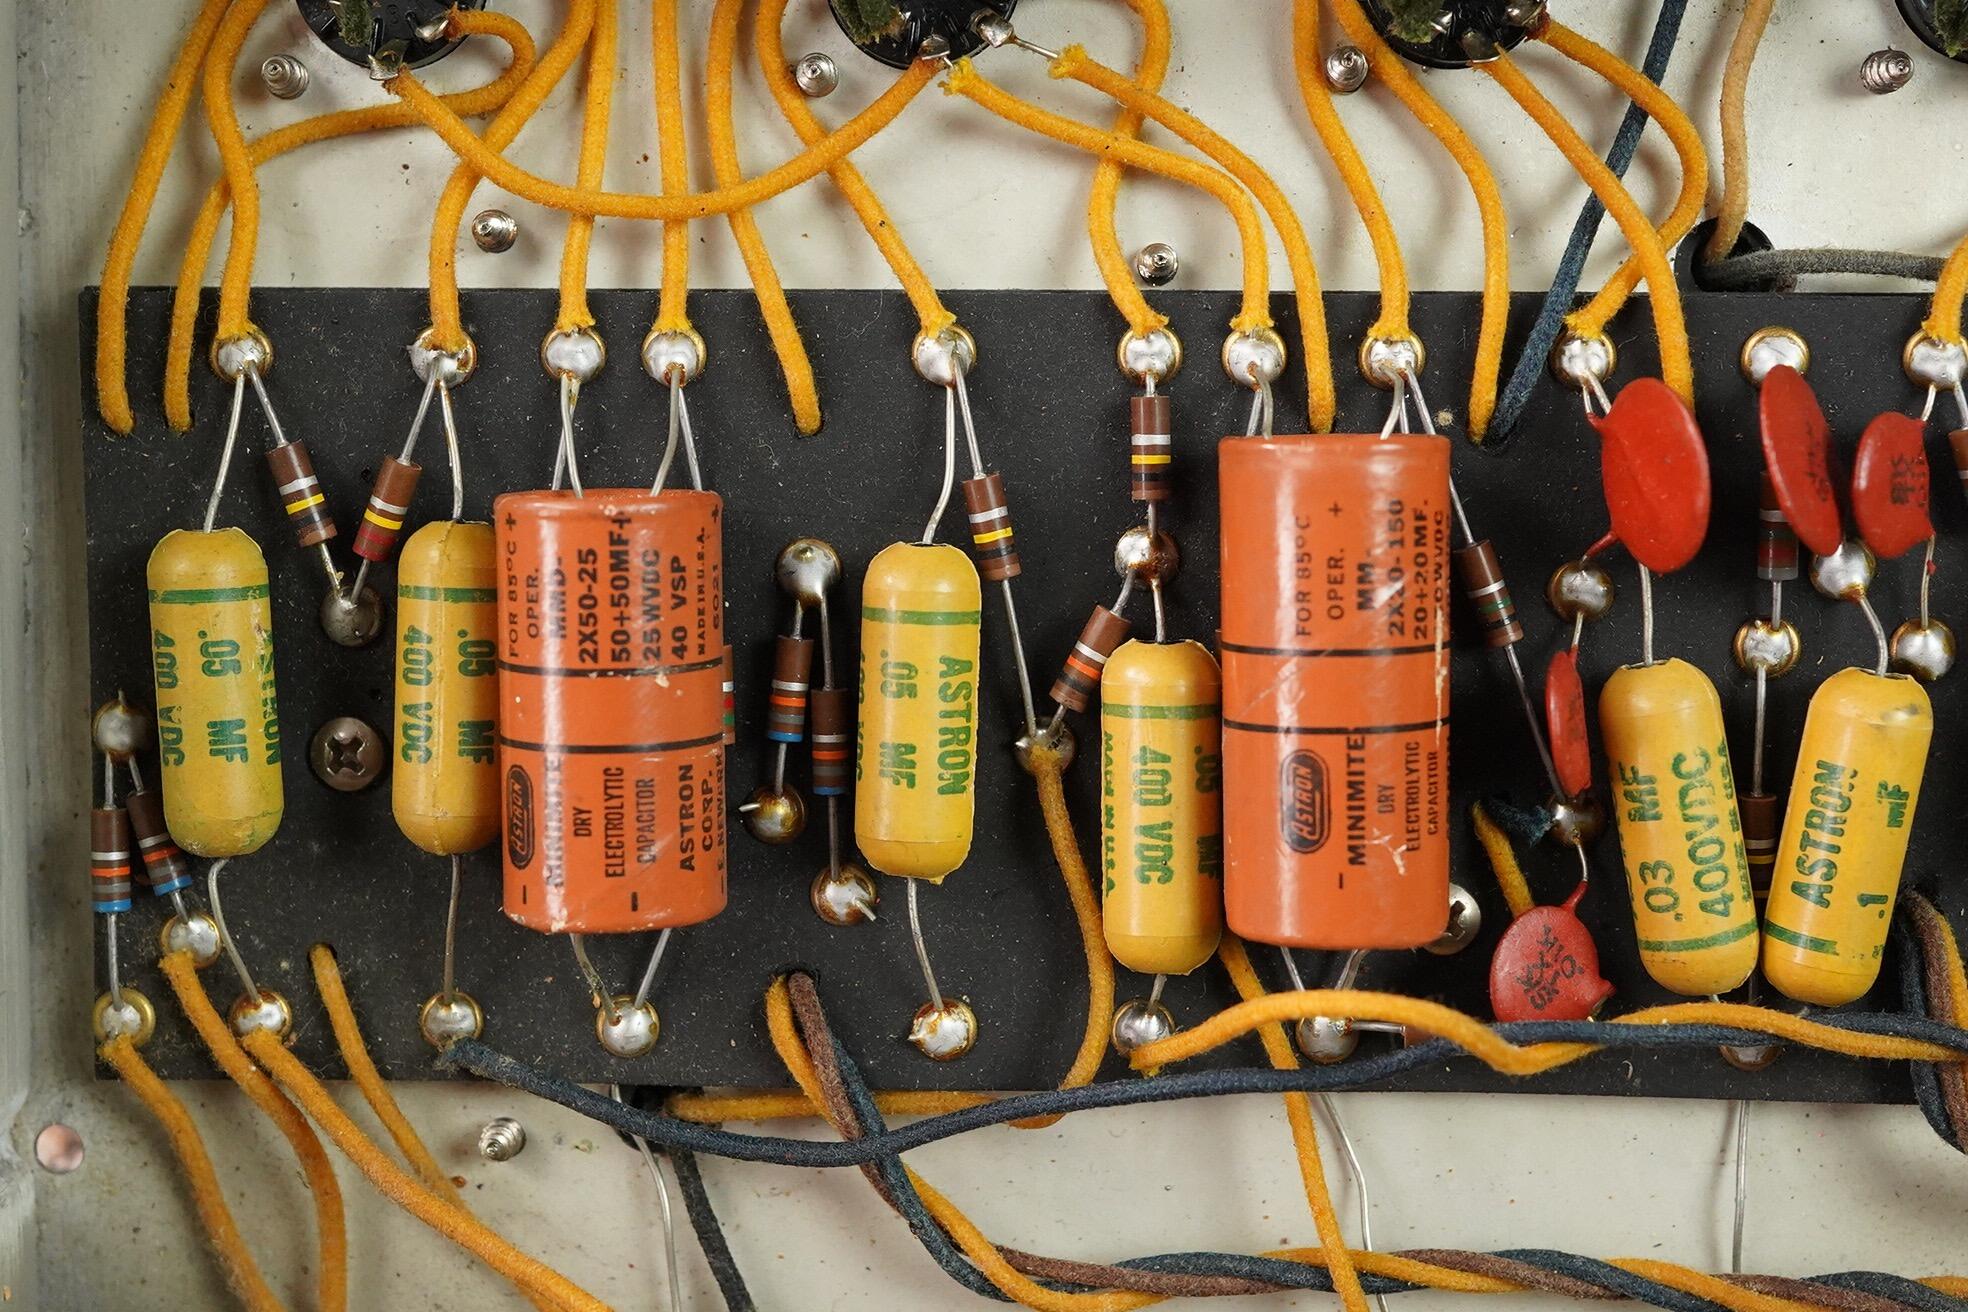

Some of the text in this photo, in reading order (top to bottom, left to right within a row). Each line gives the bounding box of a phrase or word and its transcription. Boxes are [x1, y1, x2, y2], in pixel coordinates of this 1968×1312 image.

[507, 611, 519, 658] FOR
[526, 567, 540, 639] OPER.
[577, 548, 599, 664] 2X50-25
[641, 549, 661, 662] 25 WVDC
[670, 555, 688, 660] 40 VSP
[1295, 589, 1312, 637] FOR
[1327, 547, 1345, 620] OPER.
[198, 629, 249, 764] .05 MF
[401, 625, 435, 764] 400 VDC
[457, 629, 497, 765] .05 MF
[879, 649, 919, 790] .05 MF
[937, 655, 974, 796] ASTRON
[507, 779, 528, 855] ASTRON
[572, 806, 593, 838] DRY
[603, 767, 625, 878] ELECTROLYTIC
[636, 778, 656, 864] CAPACITOR
[678, 763, 695, 872] ASTRON
[701, 770, 714, 852] CORP.
[1131, 744, 1175, 885] 400 VDC
[1289, 763, 1321, 841] ASTRON
[1346, 735, 1367, 866] MINIMITE
[1378, 784, 1396, 814] DRY
[1405, 741, 1421, 852] ELECTROLYTIC
[1426, 751, 1439, 835] CAPACITOR
[1617, 761, 1684, 922] .03 MF
[1790, 759, 1858, 910] ASTRON
[1856, 892, 1889, 920] .1
